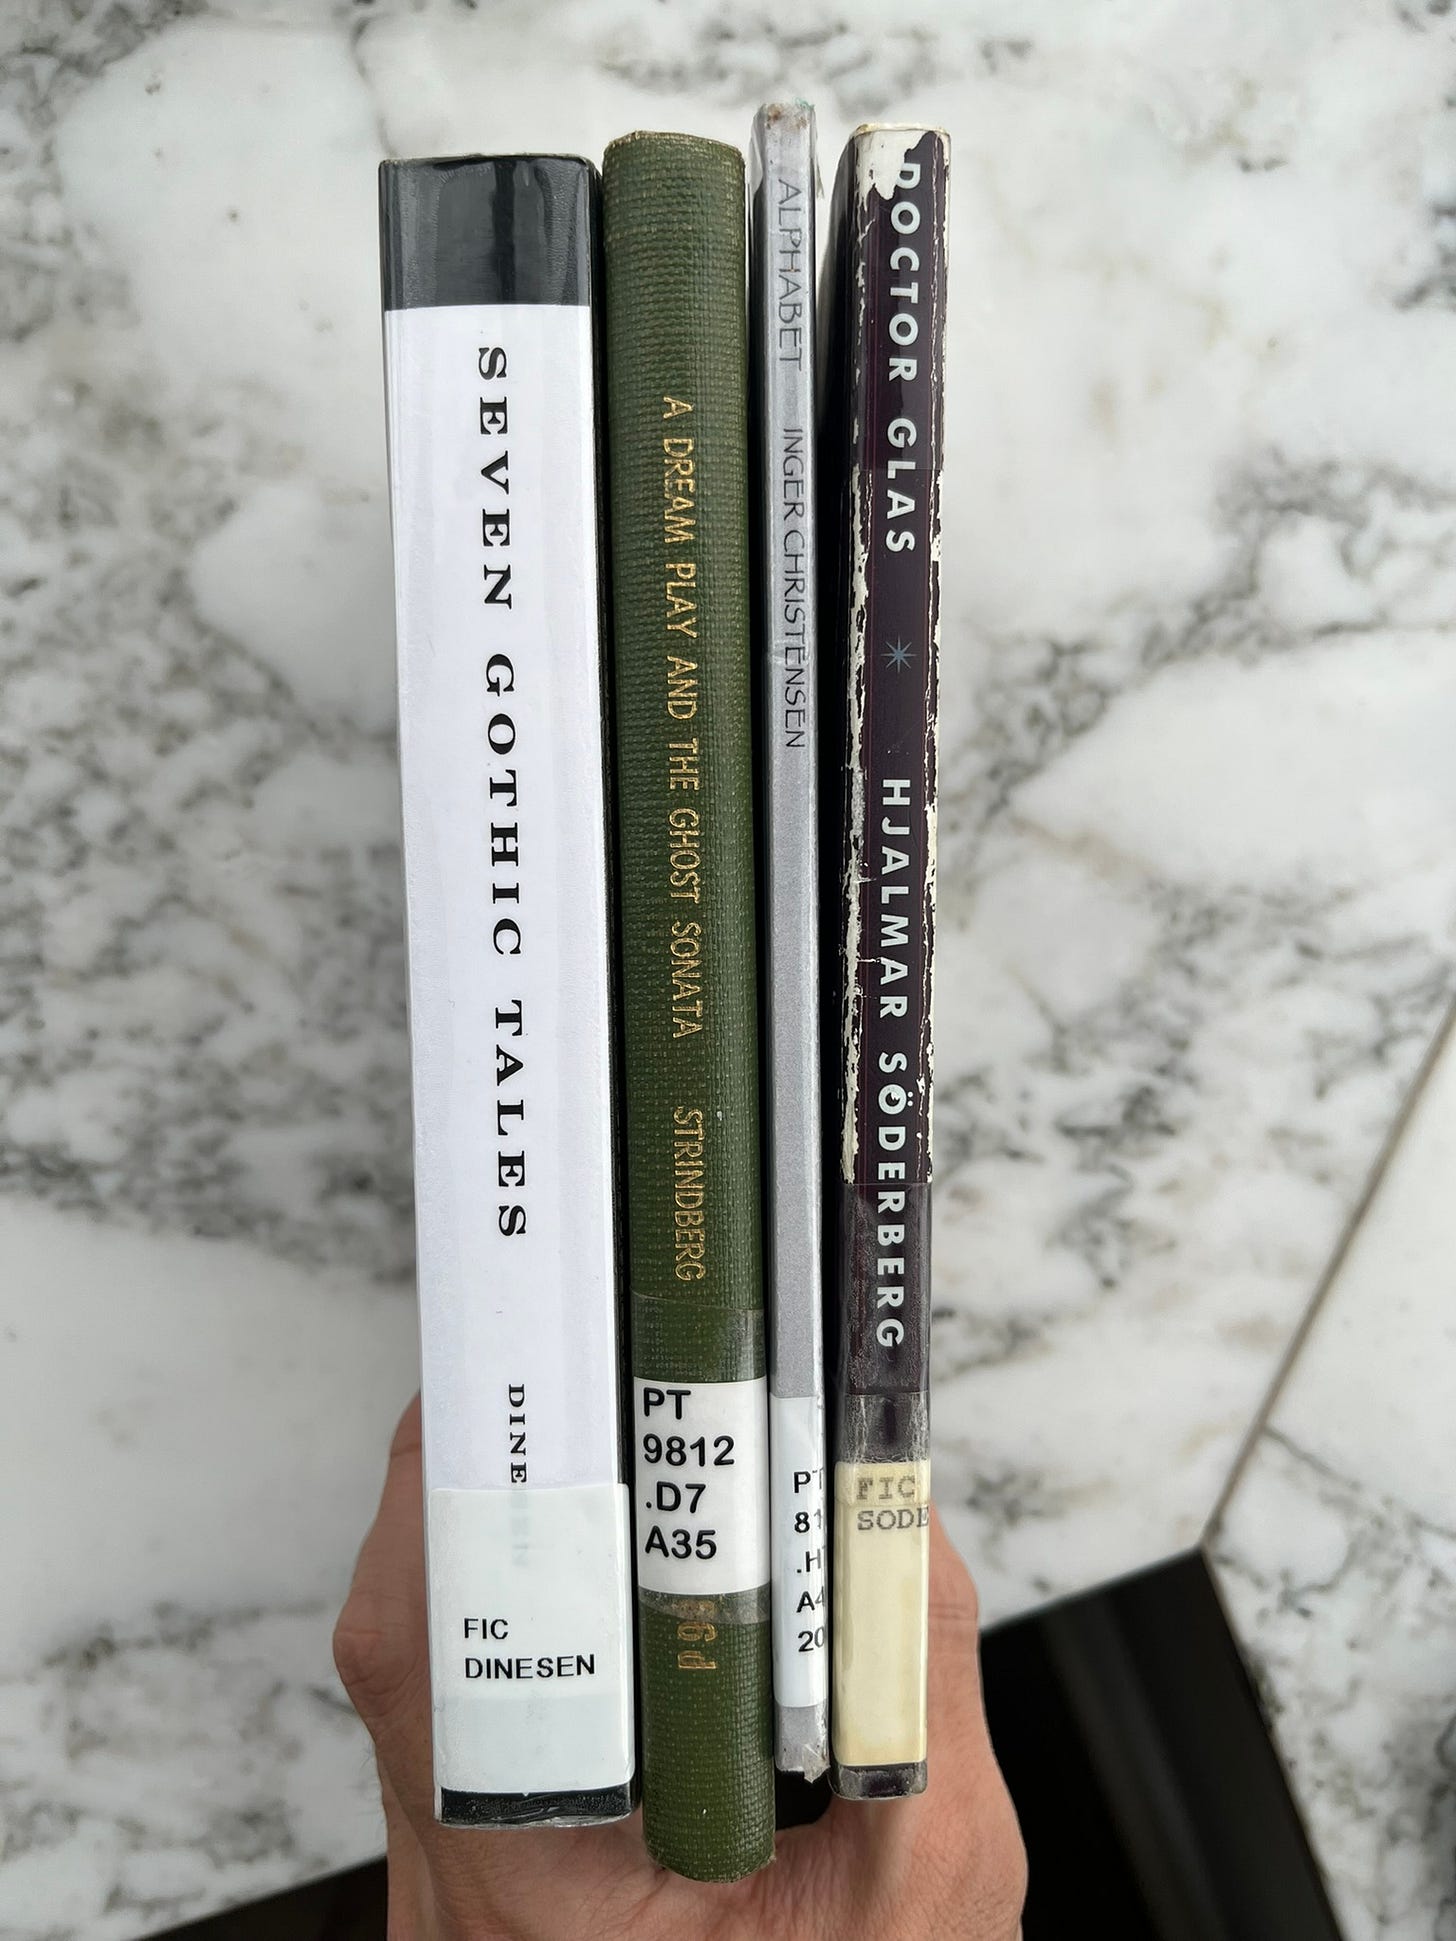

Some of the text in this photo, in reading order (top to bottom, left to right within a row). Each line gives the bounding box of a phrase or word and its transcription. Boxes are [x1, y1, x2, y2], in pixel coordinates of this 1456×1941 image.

[777, 178, 806, 749] ALPHABET INGER CHRISTENSEN
[875, 162, 921, 1347] DOCTOR GLAS HJALMAR SÖDERBERG
[478, 346, 527, 1237] SEVEN GOTHIC TALES
[662, 396, 706, 1281] A DREAM PLAY AND THE GHOST SONATA STRINDBERG
[642, 1386, 692, 1420] PT
[642, 1432, 735, 1468] 9812
[645, 1480, 706, 1514] .D7
[856, 1474, 916, 1500] FIC
[644, 1524, 717, 1560] A35
[463, 1617, 510, 1641] FIC
[464, 1653, 596, 1680] DINESEN
